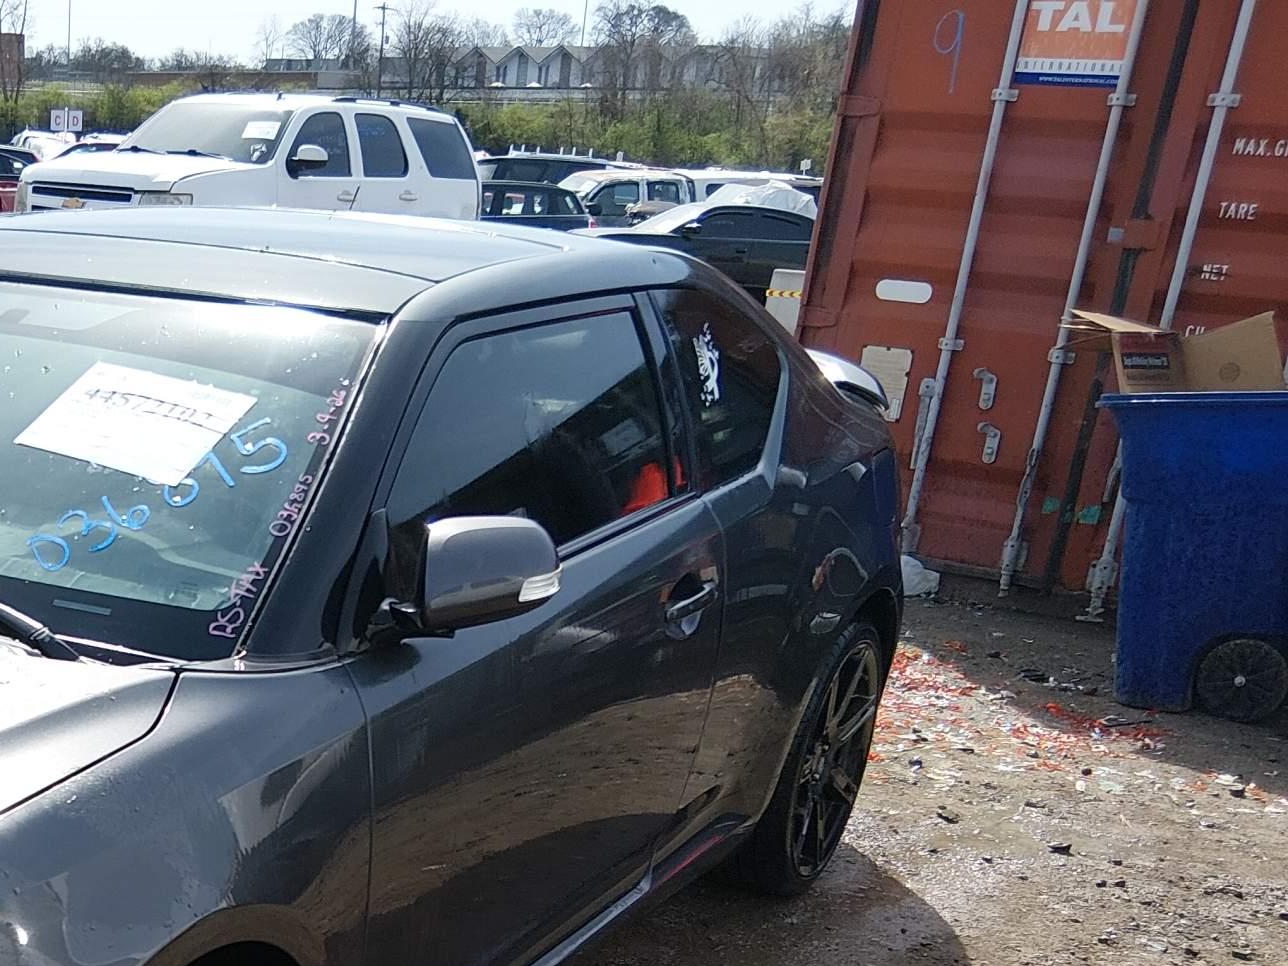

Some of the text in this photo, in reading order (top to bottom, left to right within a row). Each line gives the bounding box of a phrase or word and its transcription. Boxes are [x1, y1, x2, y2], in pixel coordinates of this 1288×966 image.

[1030, 1, 1125, 33] TAL
[933, 10, 965, 96] 9
[54, 115, 61, 126] C
[72, 115, 79, 126] D
[1232, 138, 1288, 157] MAX.G
[1219, 202, 1258, 220] TARE
[1201, 263, 1229, 281] NET
